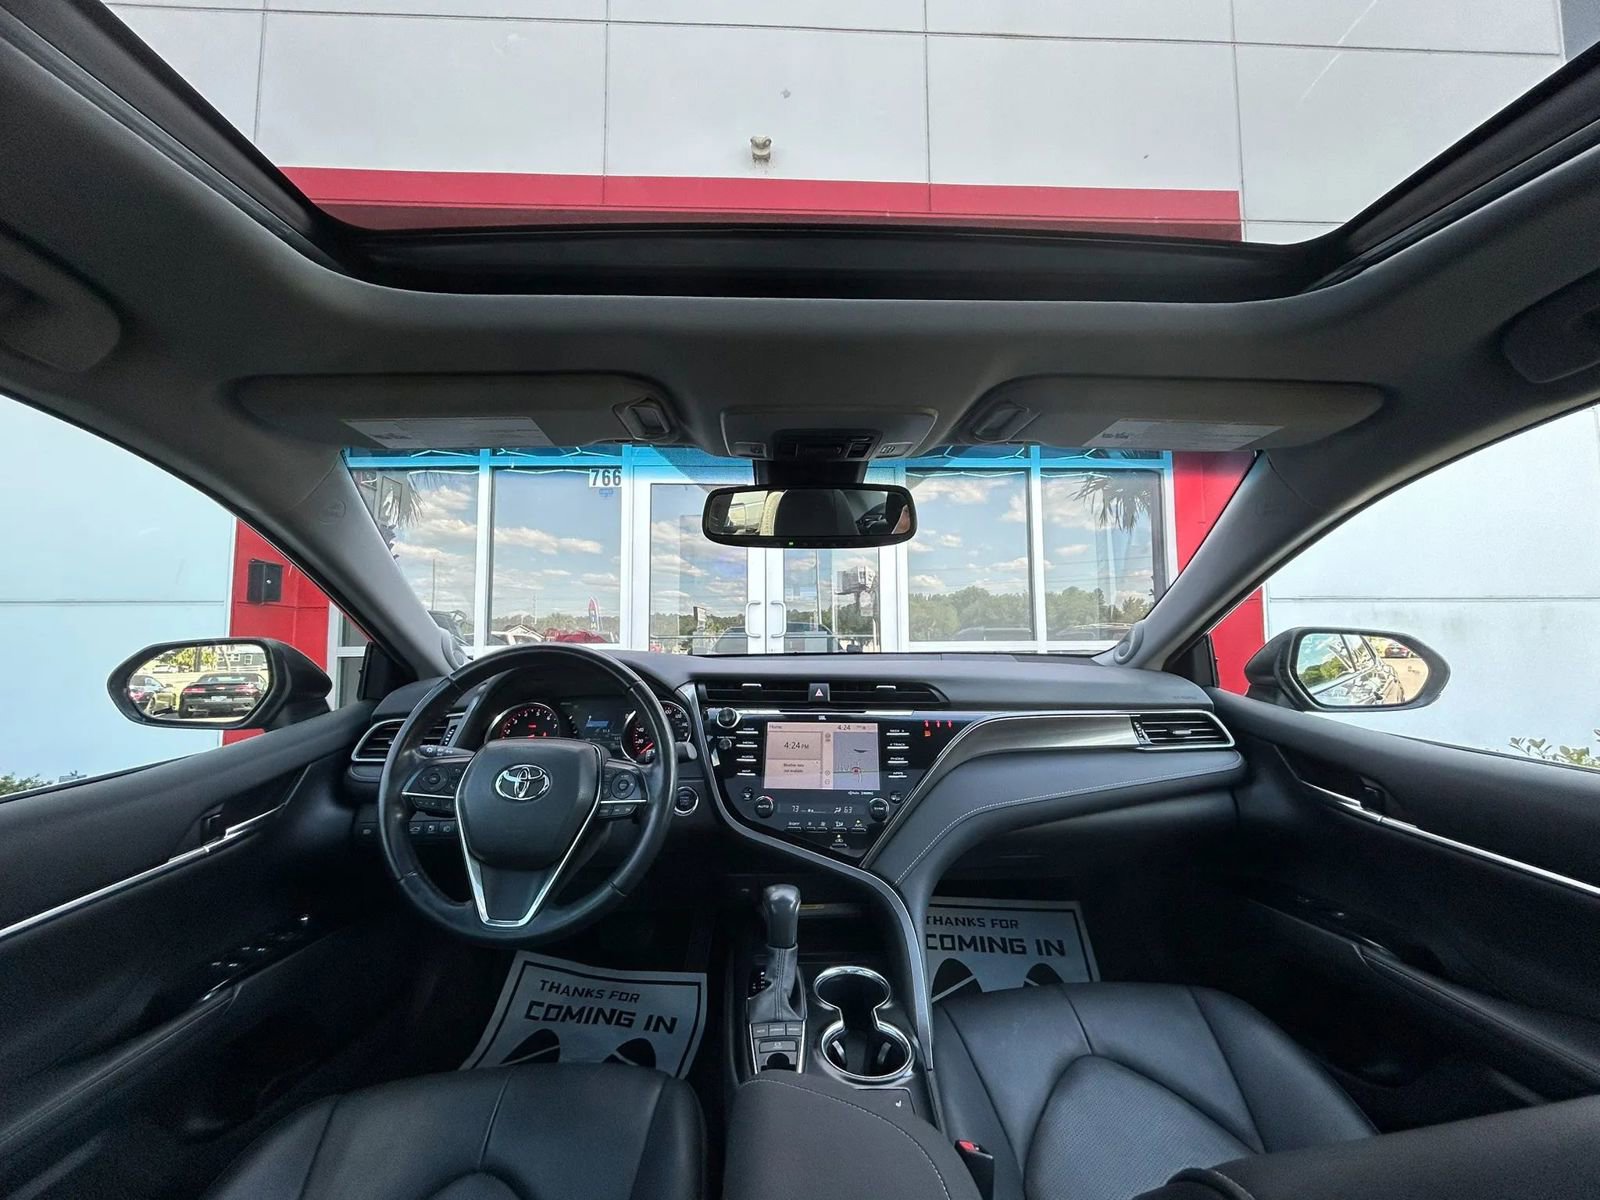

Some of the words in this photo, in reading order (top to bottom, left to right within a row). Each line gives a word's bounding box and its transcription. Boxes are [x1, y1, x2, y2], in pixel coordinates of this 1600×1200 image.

[591, 469, 621, 486] 766
[784, 741, 800, 749] 4:24
[925, 915, 986, 928] THANKS
[991, 918, 1019, 929] FOR
[926, 933, 1027, 955] COMING
[1036, 939, 1066, 957] IN
[539, 979, 604, 1000] THANKS
[608, 990, 640, 1004] FOR
[524, 1000, 636, 1028] COMING
[643, 1014, 678, 1034] IN
